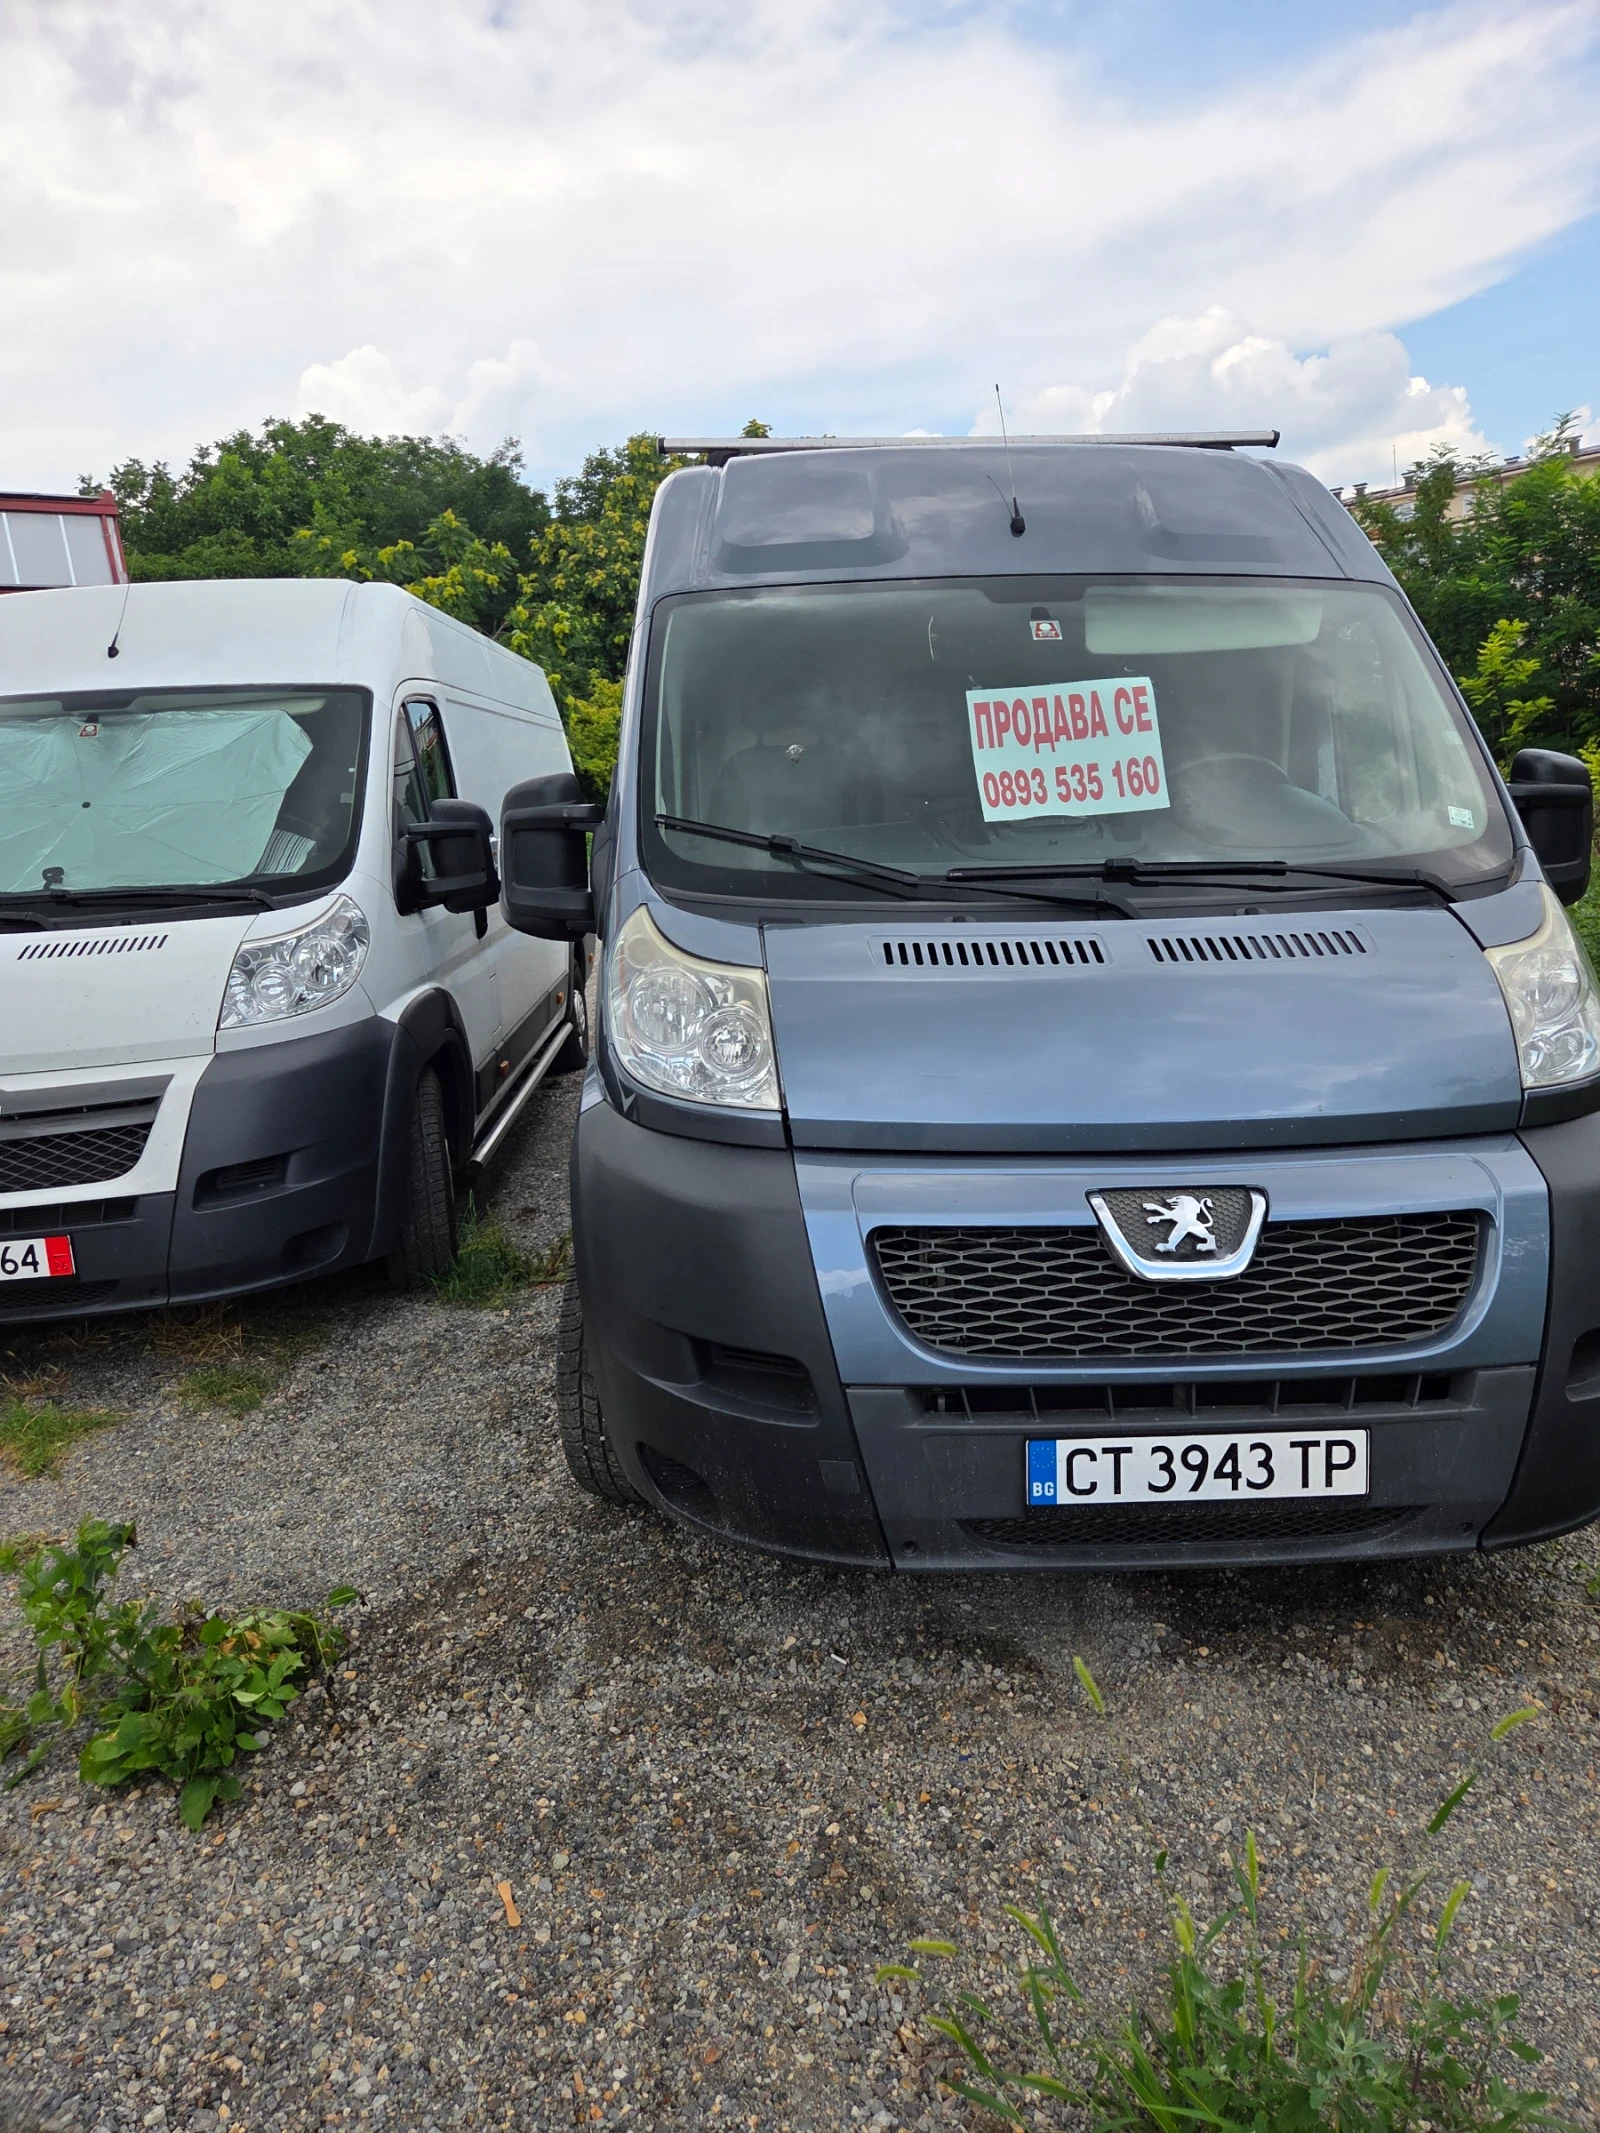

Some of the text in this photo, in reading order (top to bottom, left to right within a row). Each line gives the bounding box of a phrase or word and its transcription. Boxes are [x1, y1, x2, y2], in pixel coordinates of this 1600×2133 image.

[973, 685, 1153, 754] ПРОДАВА СЕ
[982, 755, 1160, 808] 0893 535 160
[1032, 1481, 1055, 1497] BG
[1148, 1442, 1275, 1493] 3943
